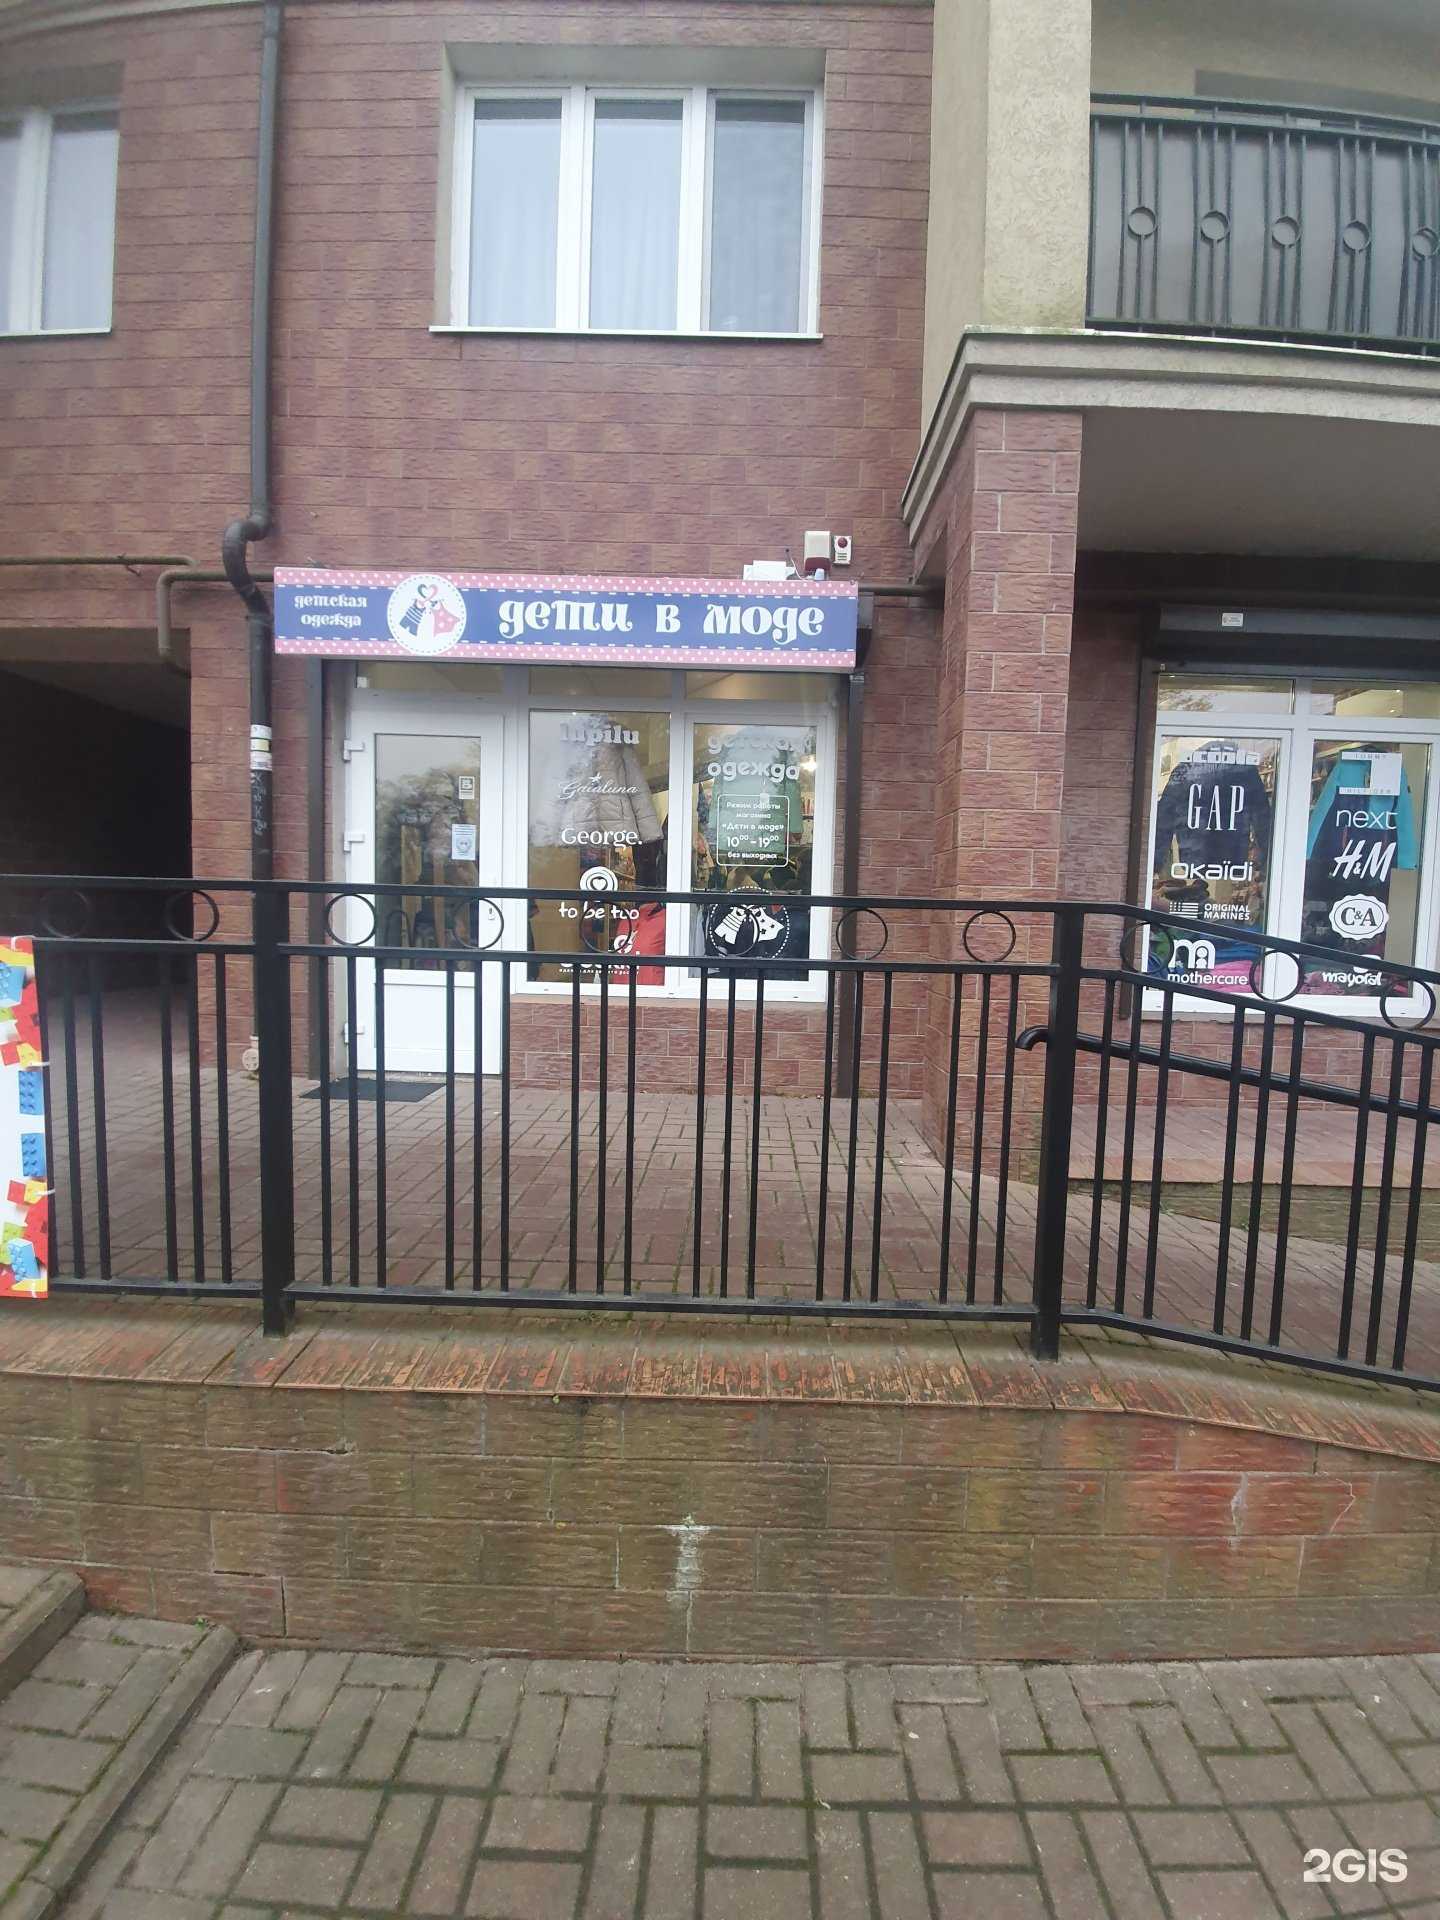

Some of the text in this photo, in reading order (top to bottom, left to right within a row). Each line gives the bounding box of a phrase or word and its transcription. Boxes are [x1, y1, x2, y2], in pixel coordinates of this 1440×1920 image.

[294, 594, 368, 609] детская
[300, 613, 361, 629] одежда
[499, 600, 825, 643] дети в моде
[707, 761, 801, 783] одежда
[1187, 783, 1245, 831] GAP
[1336, 809, 1399, 830] next
[1332, 839, 1397, 882] H&M
[558, 901, 578, 918] to
[583, 901, 605, 918] be
[1203, 912, 1250, 920] MARINES
[1204, 903, 1250, 912] ORIGINAL
[1340, 907, 1378, 927] C&A
[1168, 971, 1249, 985] mothercare
[1322, 972, 1383, 988] mayoral
